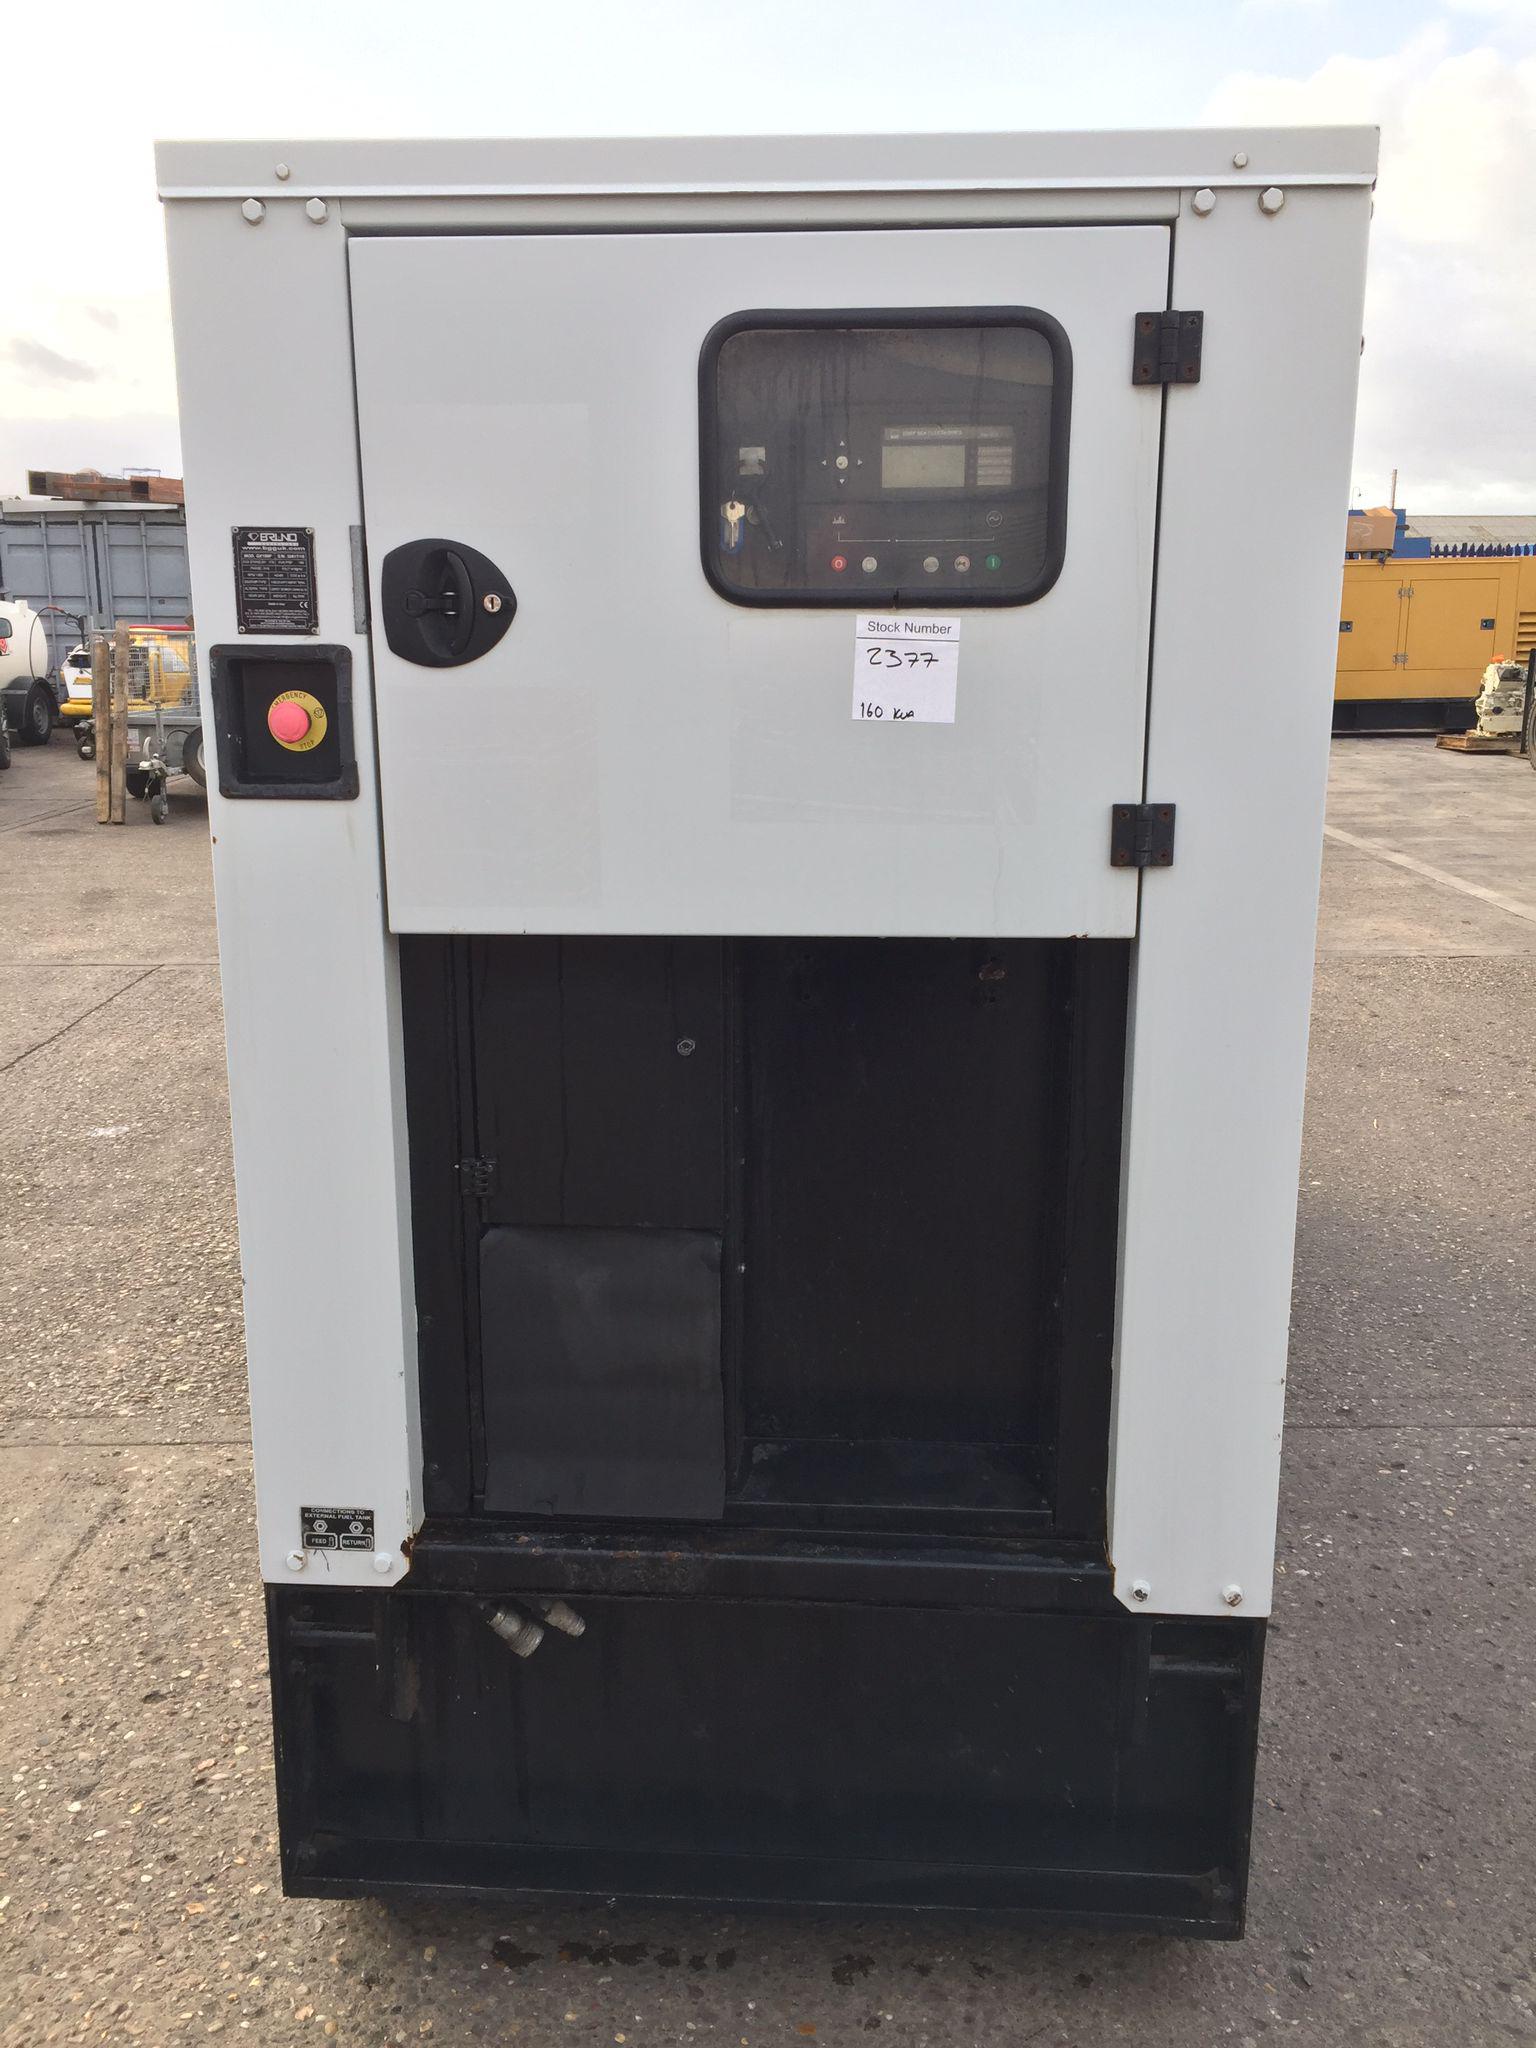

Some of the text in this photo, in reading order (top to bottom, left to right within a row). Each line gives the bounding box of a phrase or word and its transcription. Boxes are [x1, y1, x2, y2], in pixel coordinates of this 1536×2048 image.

[867, 620, 952, 634] Stock Number
[866, 647, 939, 668] 2377
[860, 702, 884, 719] 160
